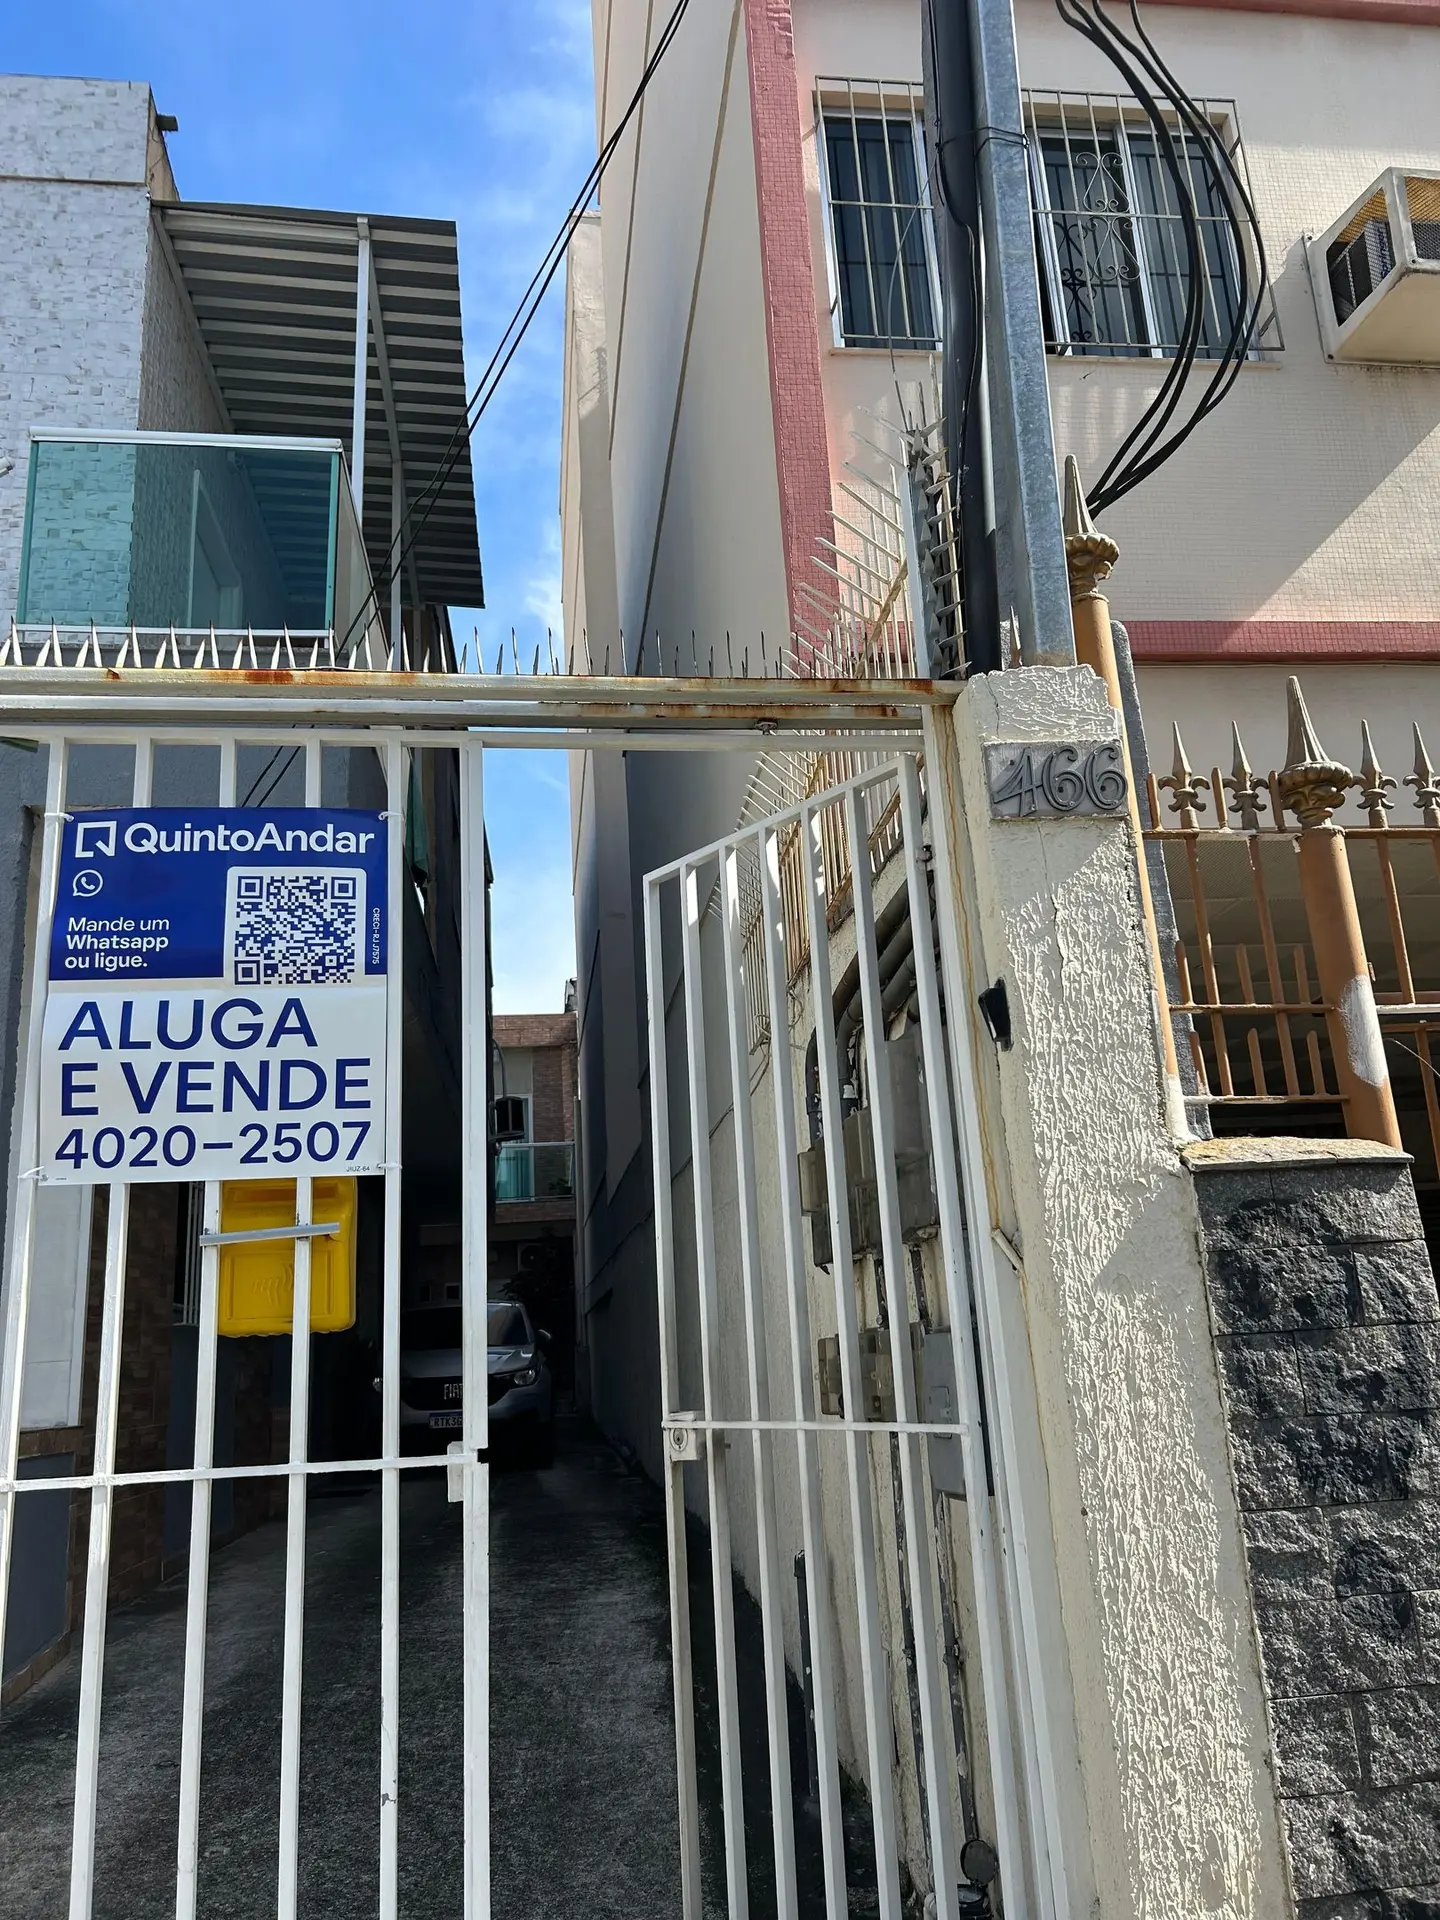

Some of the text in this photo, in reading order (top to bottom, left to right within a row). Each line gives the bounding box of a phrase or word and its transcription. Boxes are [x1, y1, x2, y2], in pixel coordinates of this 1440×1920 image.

[993, 745, 1128, 817] 466
[124, 822, 375, 854] QuintoAndar
[66, 934, 169, 952] Whatsapp
[68, 916, 170, 932] Mande um
[371, 907, 381, 965] CRECI-RJ J7575
[64, 952, 148, 972] ou ligue.
[57, 997, 318, 1051] ALUGA
[61, 1057, 371, 1116] E VENDE
[55, 1120, 371, 1169] 4020-2507
